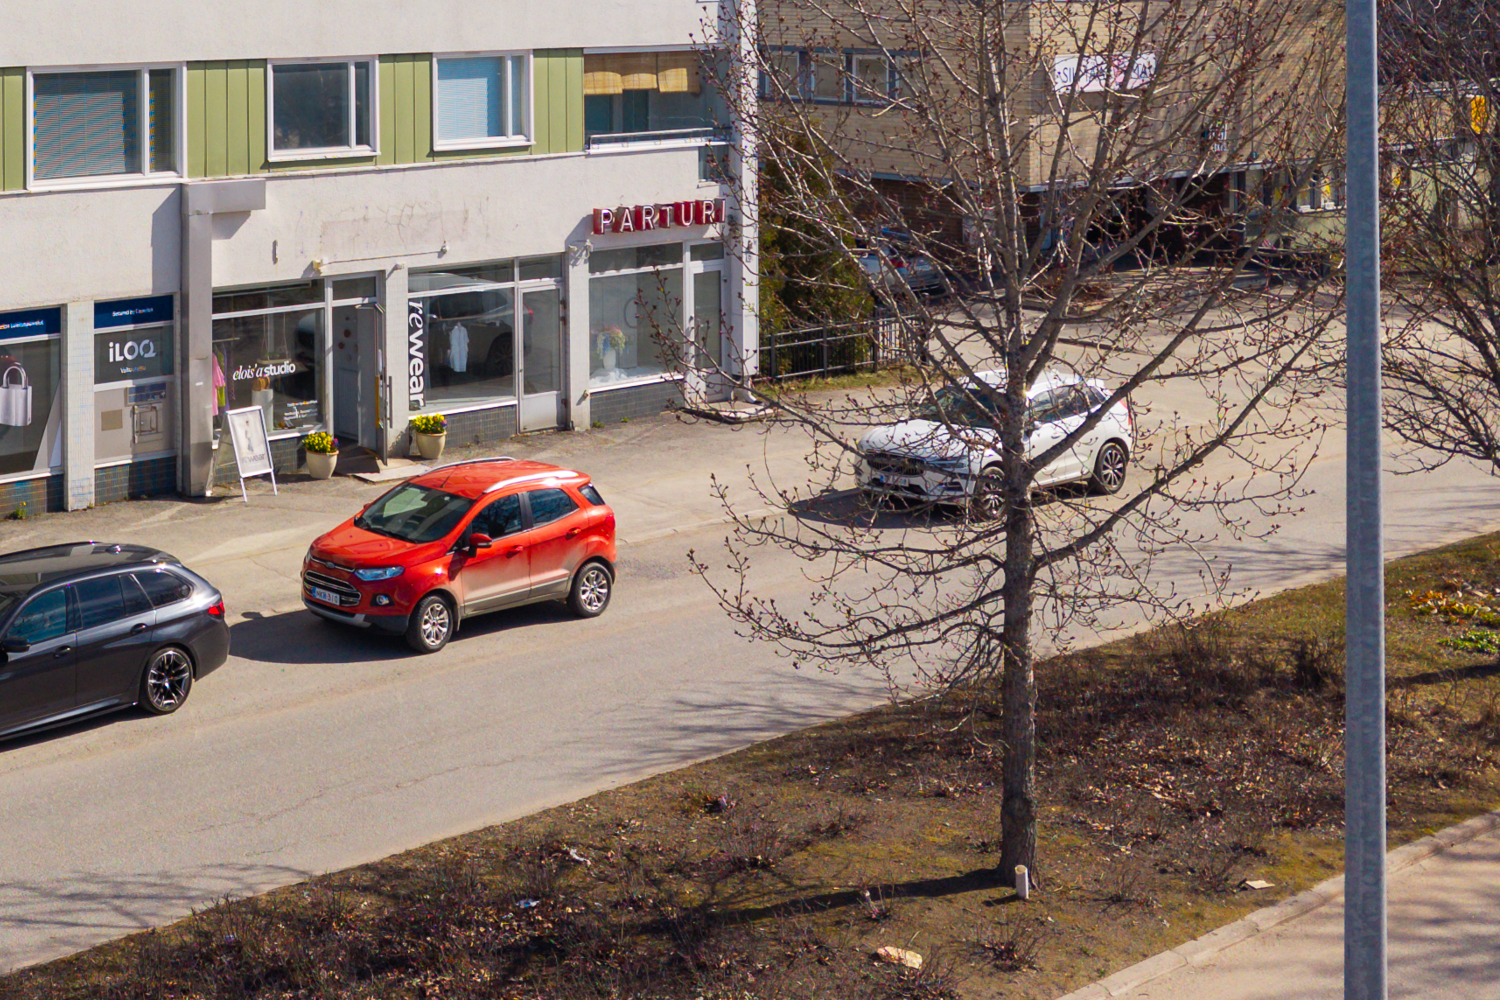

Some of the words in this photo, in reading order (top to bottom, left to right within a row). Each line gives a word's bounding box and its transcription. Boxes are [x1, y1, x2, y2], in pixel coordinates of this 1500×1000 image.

[594, 199, 726, 234] PARTURI
[108, 339, 157, 363] iLOQ
[408, 300, 425, 407] rewear
[263, 360, 296, 377] studio
